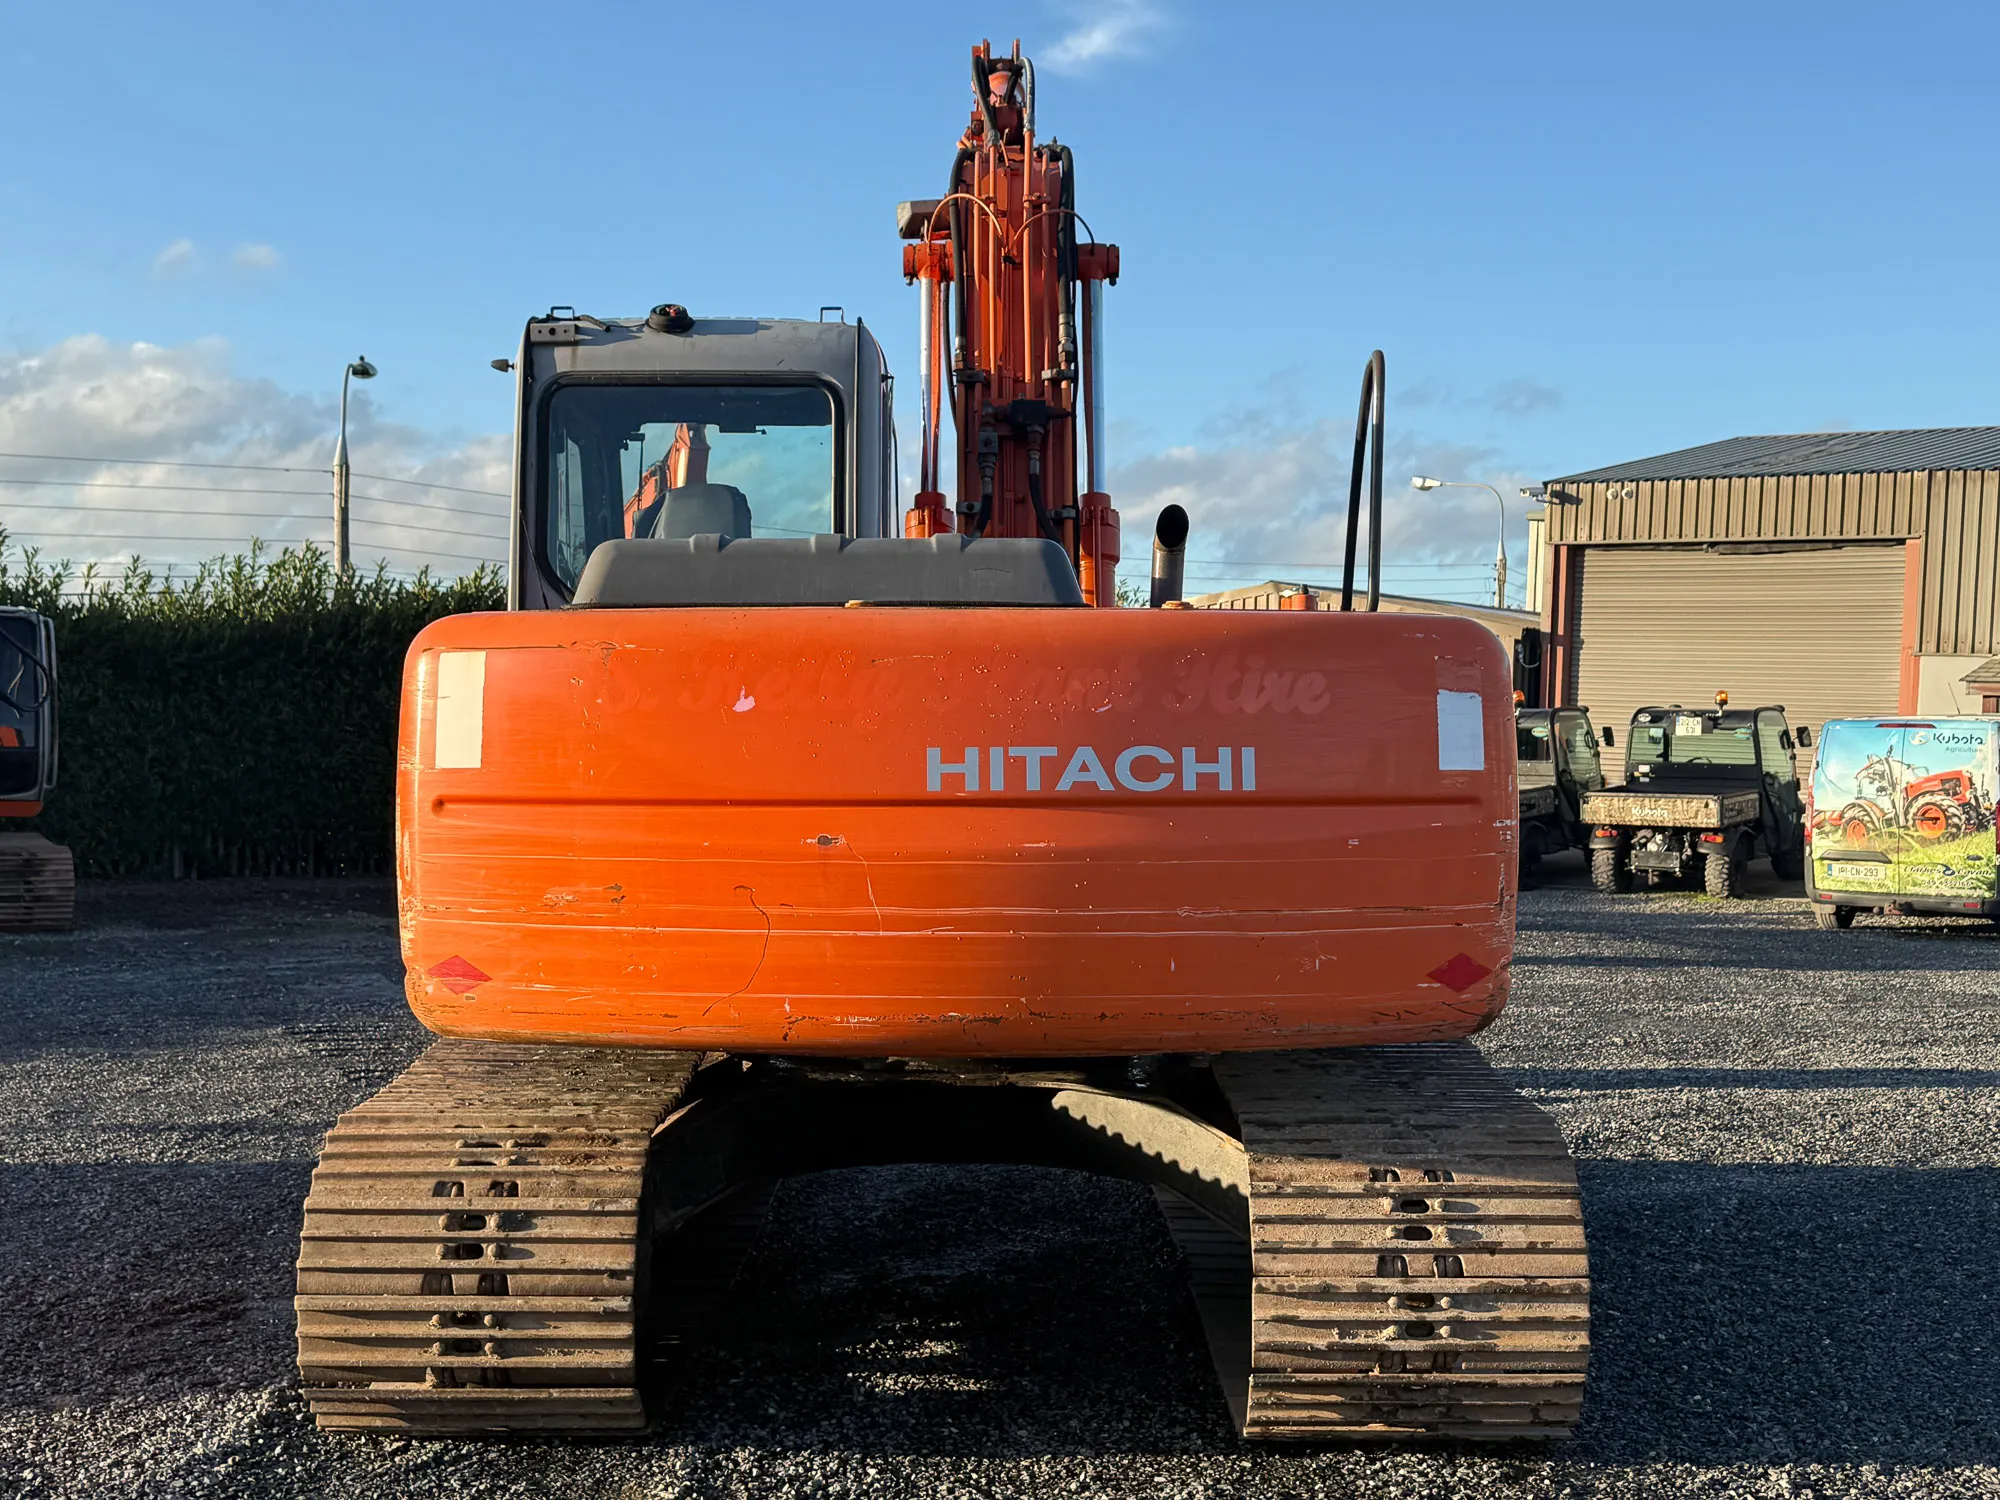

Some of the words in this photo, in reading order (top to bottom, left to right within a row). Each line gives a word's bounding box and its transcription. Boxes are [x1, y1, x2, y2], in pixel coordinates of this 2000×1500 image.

[1933, 732, 1984, 745] Kubota
[1944, 746, 1984, 754] Agriculture
[926, 745, 1256, 792] HITACHI
[1631, 806, 1668, 817] Kubota
